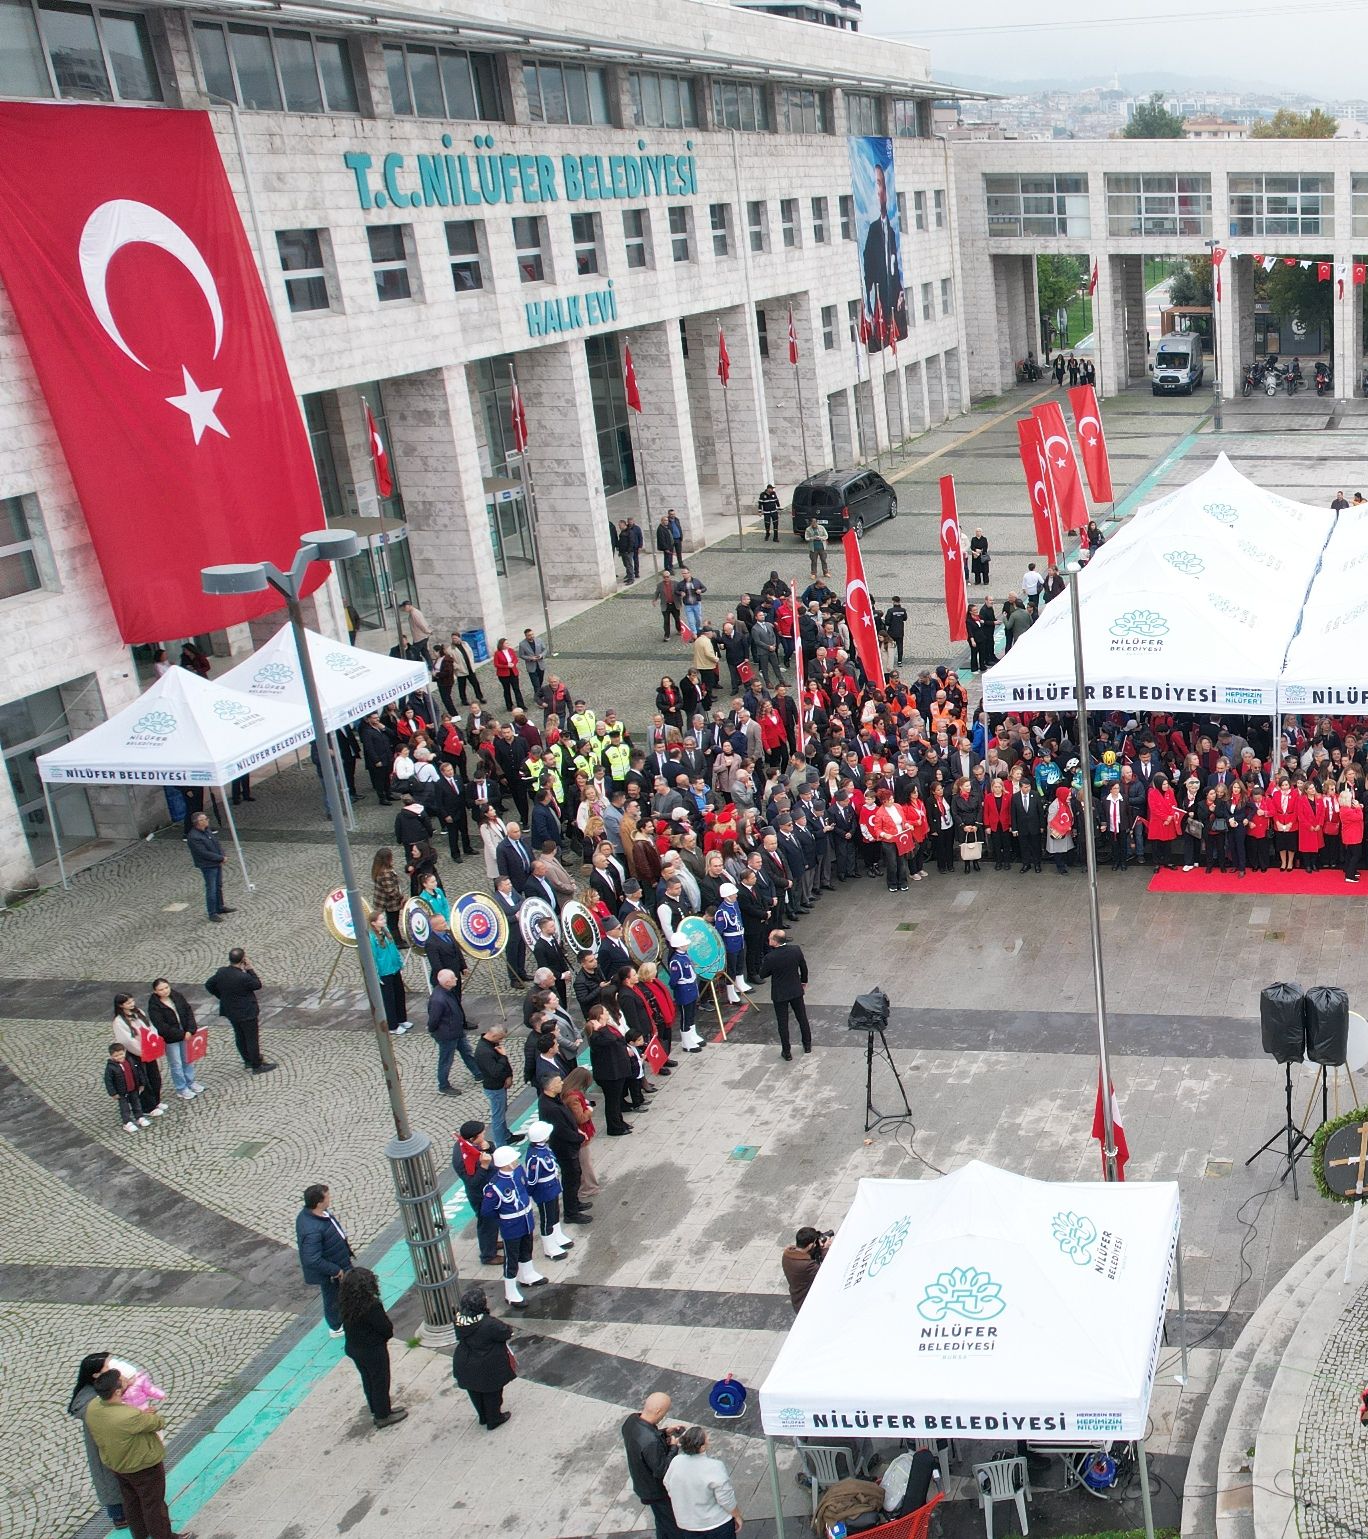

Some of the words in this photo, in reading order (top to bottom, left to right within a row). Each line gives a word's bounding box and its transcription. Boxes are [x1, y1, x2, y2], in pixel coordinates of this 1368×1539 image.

[562, 139, 698, 199] BELEDİYESİ
[525, 297, 583, 337] HALK
[585, 280, 617, 325] EVİ
[348, 698, 376, 718] NİLÜFER
[377, 680, 413, 703] BELEDİYESİ
[1102, 683, 1217, 702] BELEDİYESİ
[236, 748, 270, 771] NİLÜFER
[271, 728, 314, 754] BELEDİYESİ
[65, 768, 116, 779] NİLÜFER
[119, 770, 187, 781] BELEDİYESİ
[1094, 1230, 1113, 1274] NİLÜFER
[1107, 1236, 1123, 1281] BELEDİYESİ
[918, 1340, 995, 1351] BELEDİYESİ
[920, 1323, 998, 1338] NİLÜFER
[812, 1410, 916, 1428] NİLÜFER
[925, 1411, 1066, 1430] BELEDİYESİ
